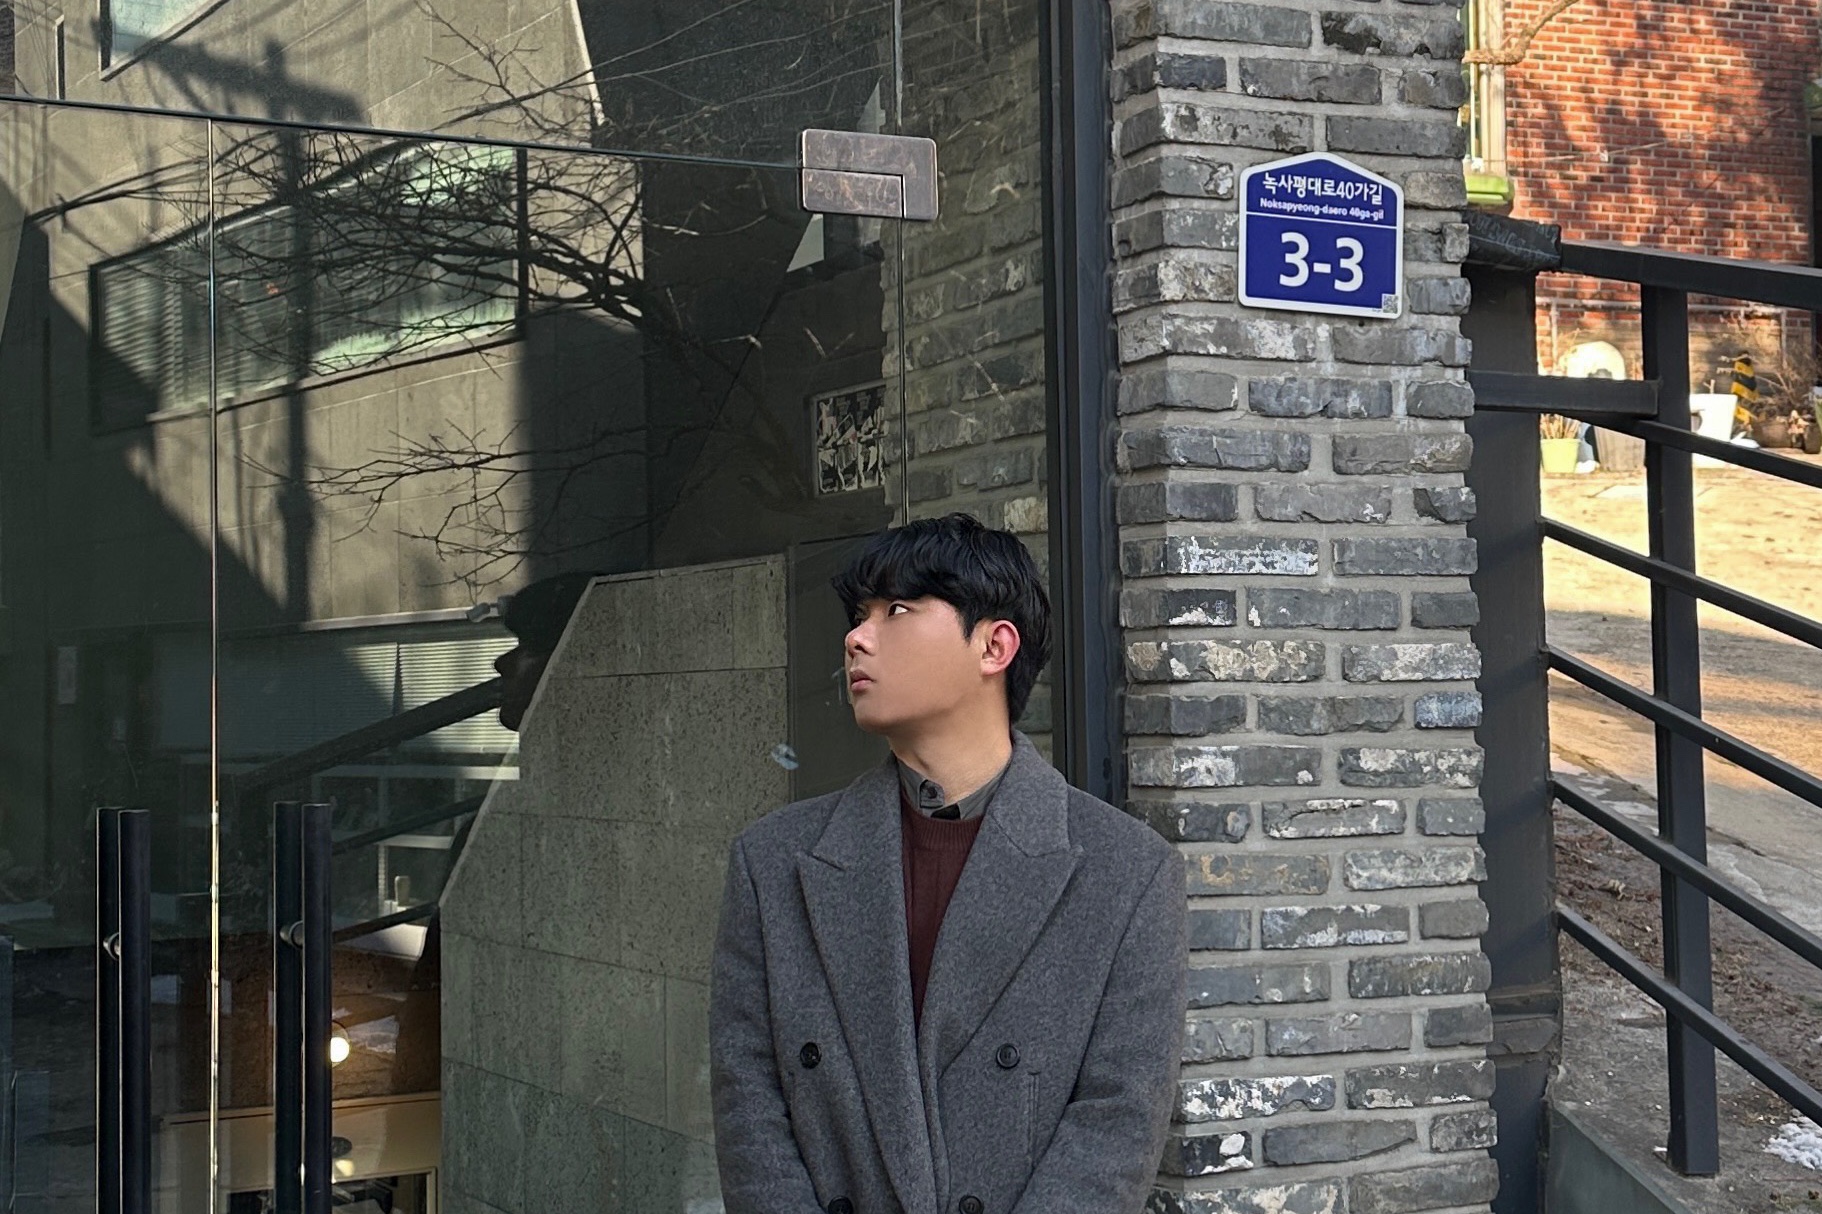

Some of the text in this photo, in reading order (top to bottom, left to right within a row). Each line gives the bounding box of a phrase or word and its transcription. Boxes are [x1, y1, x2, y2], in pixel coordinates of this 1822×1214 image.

[1263, 172, 1383, 205] 녹사평대로40가길
[1260, 197, 1348, 215] Noksapyeong-daero
[1279, 231, 1364, 292] 3-3
